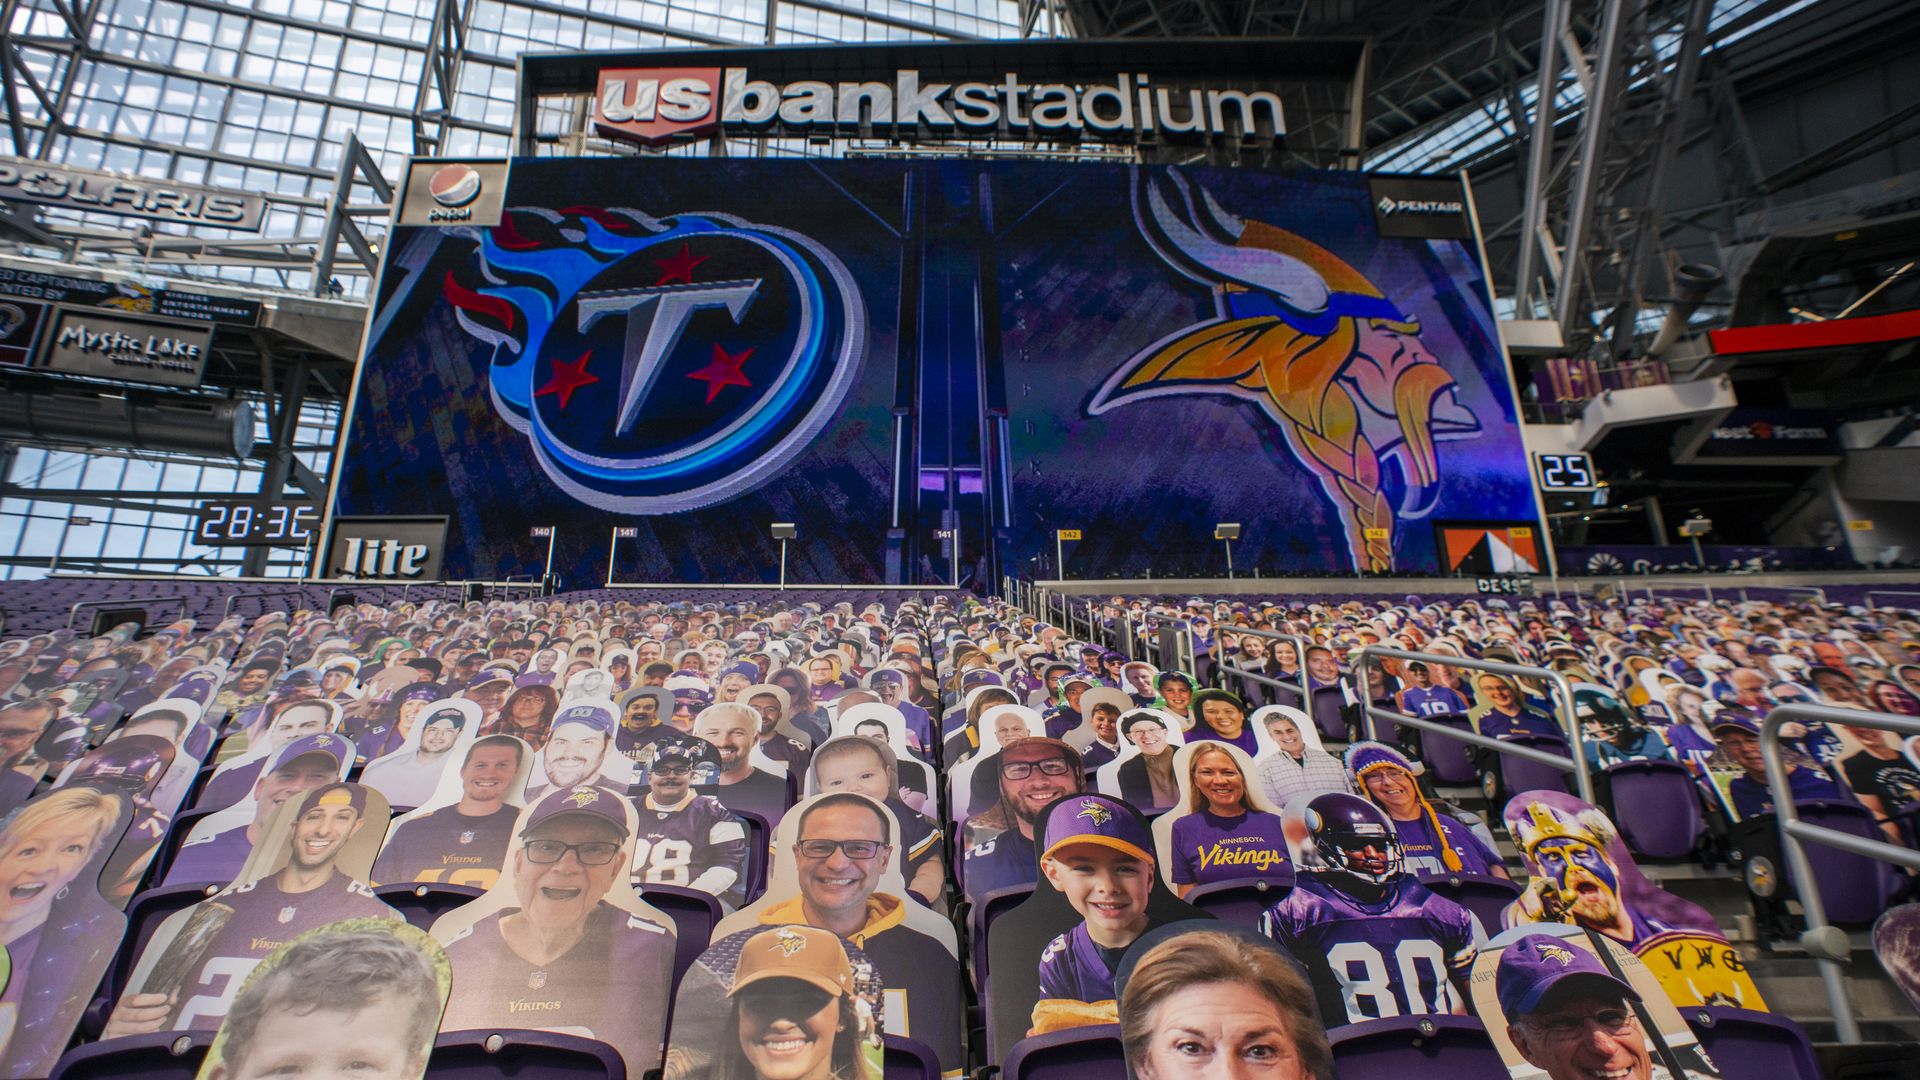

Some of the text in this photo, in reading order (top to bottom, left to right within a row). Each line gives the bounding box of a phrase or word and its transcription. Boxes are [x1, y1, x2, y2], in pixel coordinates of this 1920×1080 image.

[1397, 200, 1462, 212] PENTAIR
[428, 207, 471, 223] pepsi
[17, 272, 109, 294] CAPTIONING
[44, 288, 66, 300] BY
[163, 291, 209, 303] VIKINGS
[160, 308, 213, 320] NETWORK
[162, 300, 250, 316] ENTERTAINMENT
[1543, 456, 1589, 486] 25
[534, 527, 550, 536] 140
[620, 528, 634, 537] 141
[937, 530, 951, 539] 141
[1063, 531, 1078, 539] 142
[1369, 530, 1384, 538] 142
[1219, 836, 1265, 845] MINNESOTA
[1197, 843, 1284, 871] Vikings
[1326, 939, 1452, 1025] 80
[1698, 1012, 1710, 1023] 19
[1421, 1022, 1433, 1033] 18
